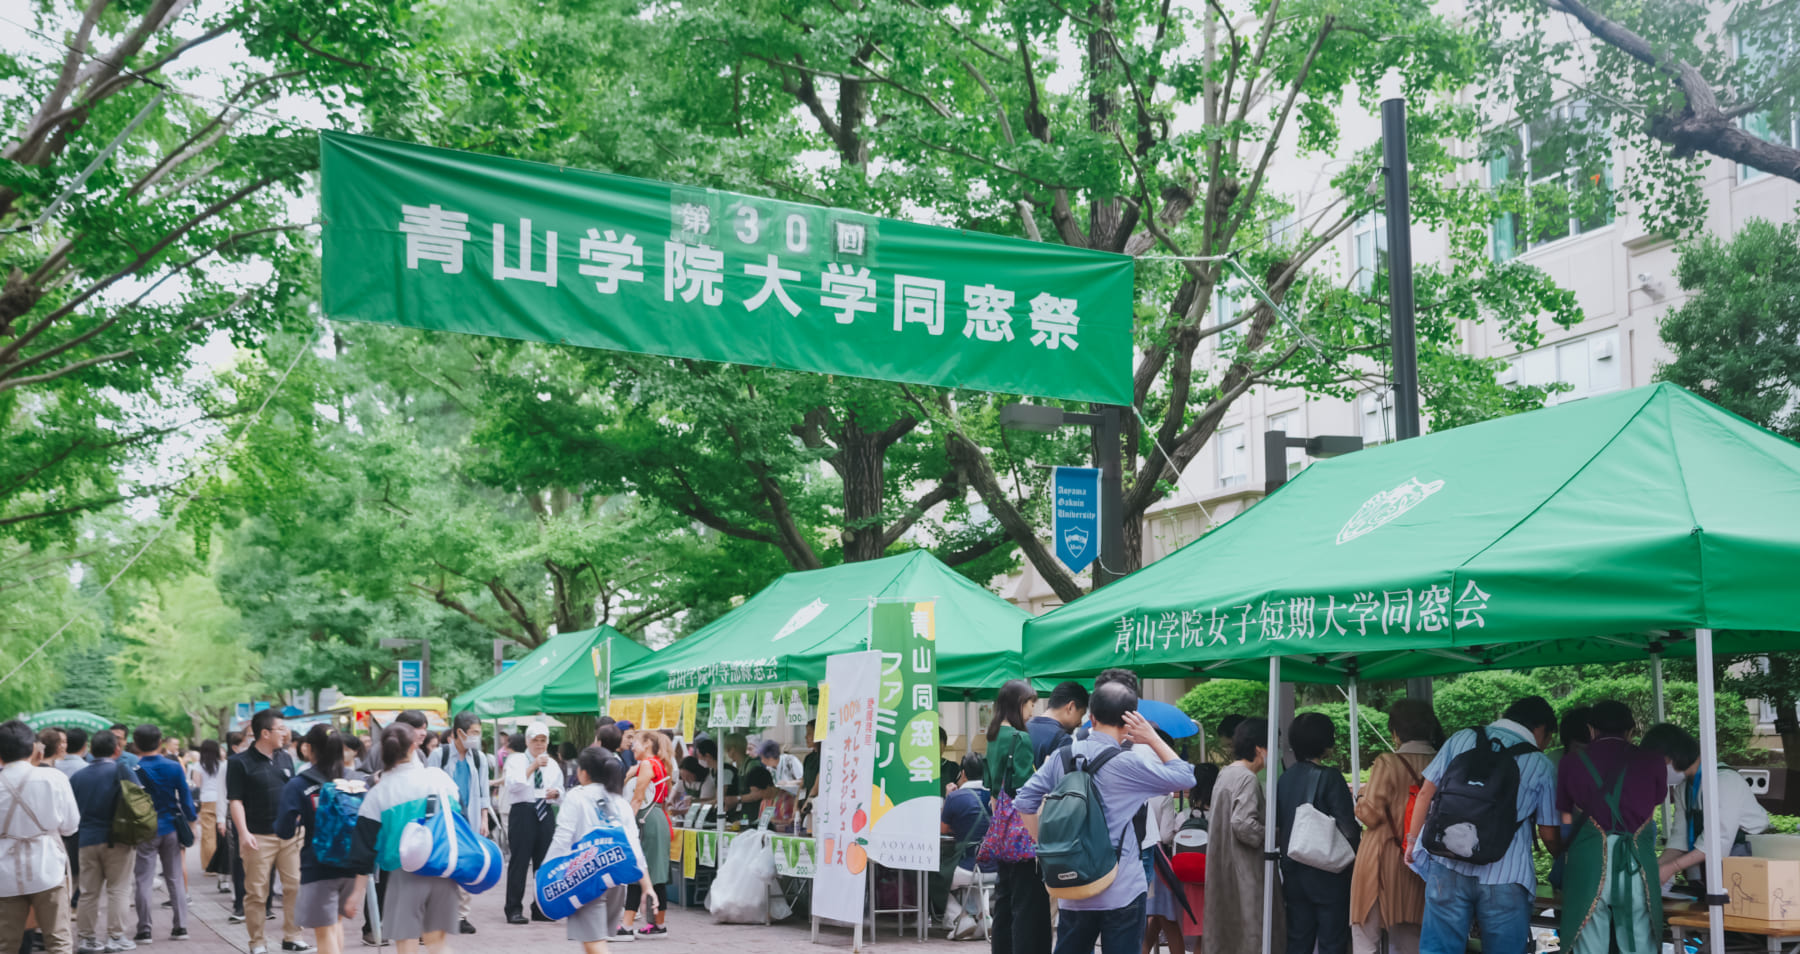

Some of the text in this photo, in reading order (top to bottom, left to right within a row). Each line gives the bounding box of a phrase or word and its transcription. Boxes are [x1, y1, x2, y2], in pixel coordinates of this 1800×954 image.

[680, 203, 867, 256] 第30回
[399, 203, 1081, 351] 青山学院大学同窓祭
[1057, 486, 1087, 496] Aoyama
[1057, 509, 1096, 520] University
[1113, 579, 1492, 655] 青山学院女子短期大学同窓会
[909, 610, 934, 783] 青山同窓会
[875, 652, 903, 807] ファミリー
[879, 853, 932, 865] FAMILY
[880, 840, 934, 852] AOYAMA
[543, 847, 625, 901] CHEERLEADER
